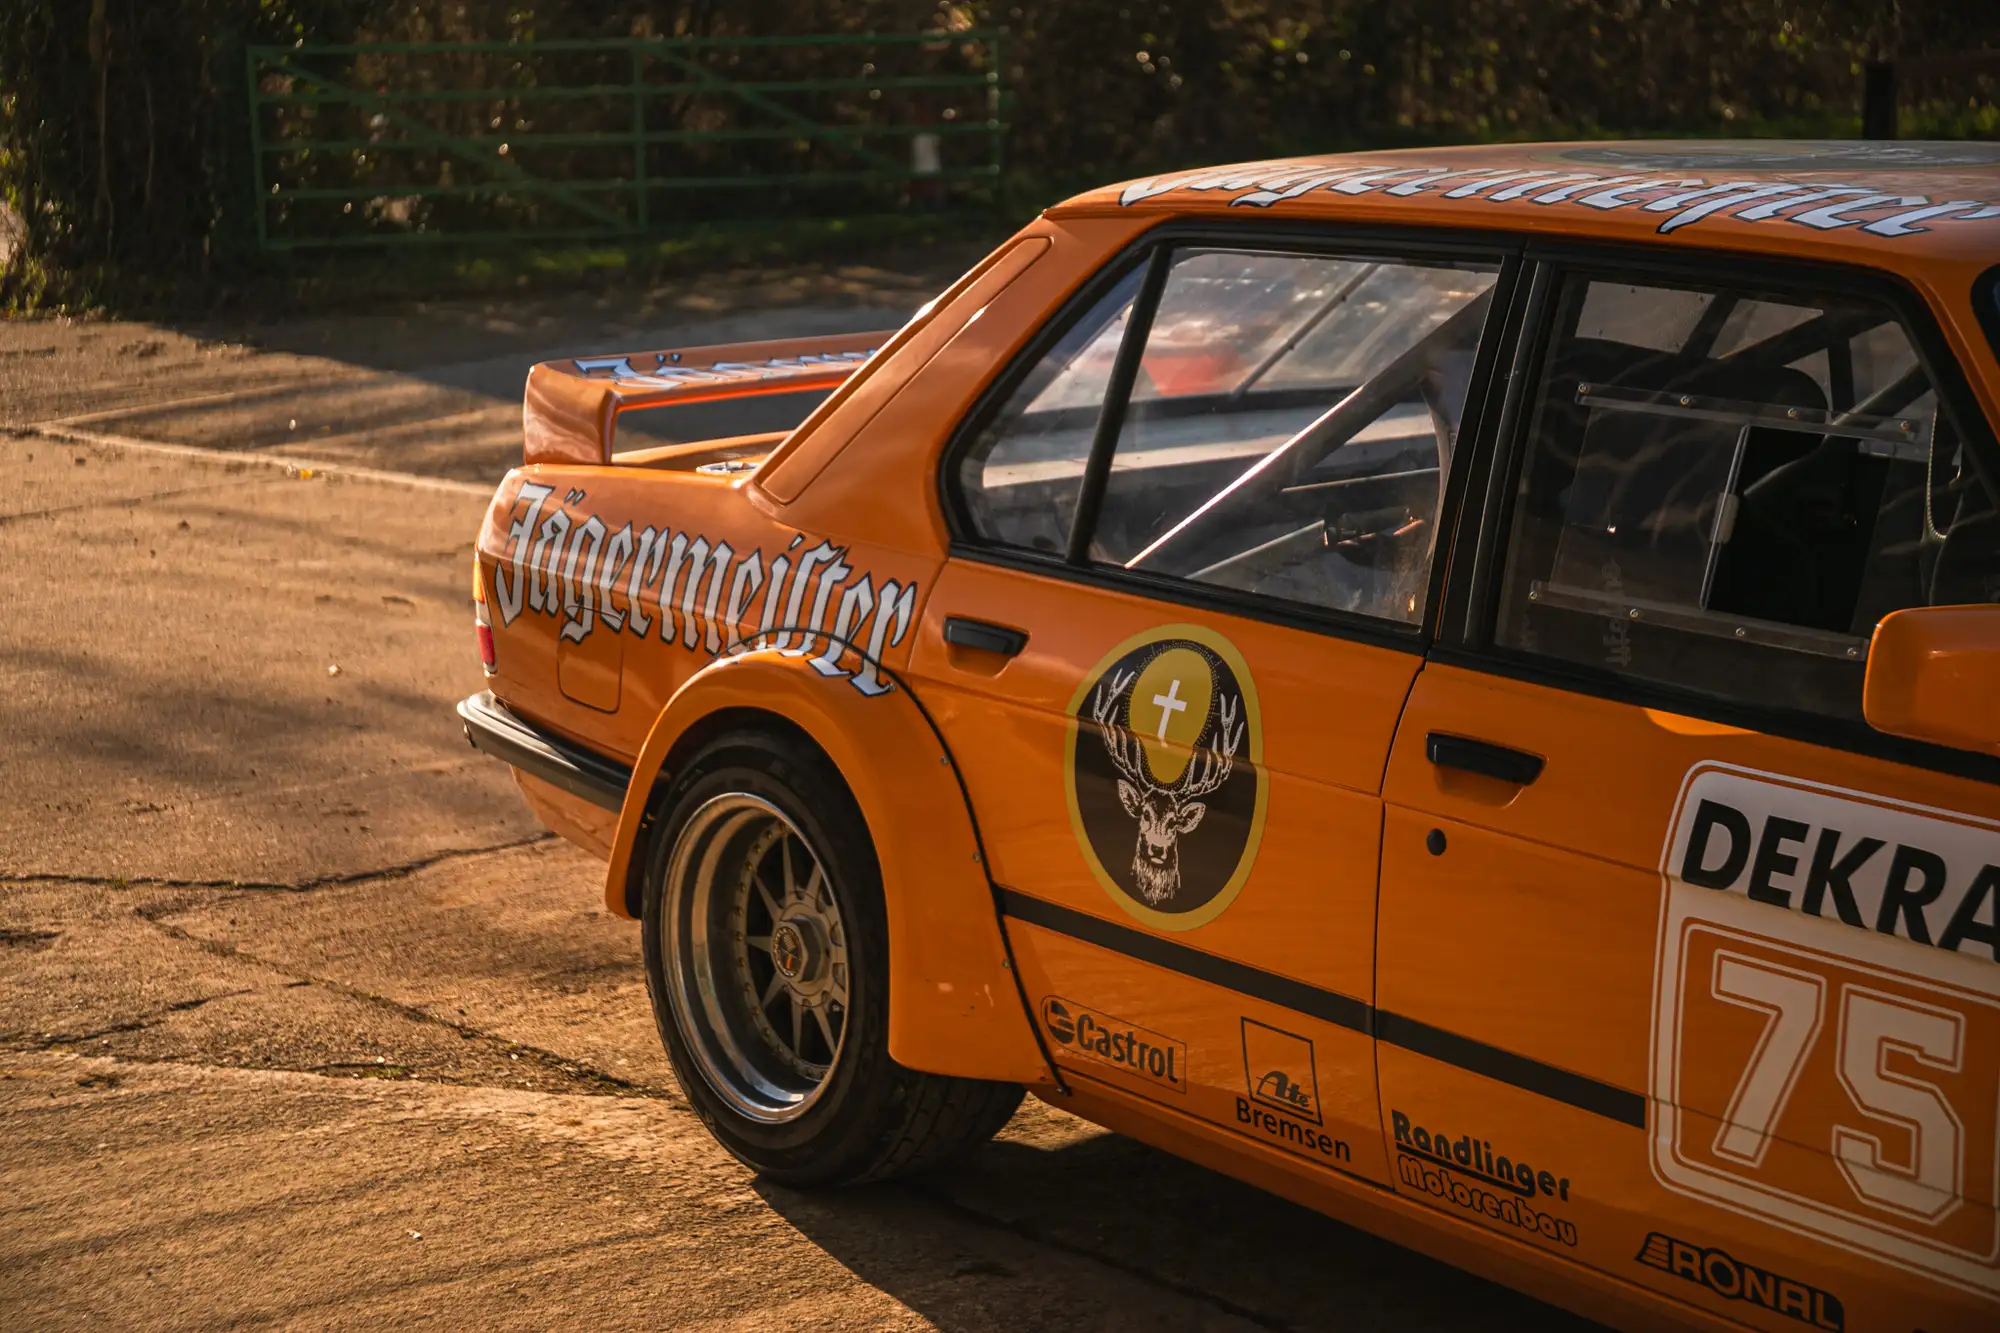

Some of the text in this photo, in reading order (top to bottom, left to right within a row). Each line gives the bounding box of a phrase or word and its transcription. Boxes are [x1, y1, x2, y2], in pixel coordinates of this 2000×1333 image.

[494, 480, 918, 698] Jägermeister
[1077, 1014, 1178, 1083] Castrol
[1711, 948, 1966, 1226] 75
[1236, 1097, 1350, 1161] Bremsen
[1392, 1109, 1570, 1202] Randlinger
[1398, 1154, 1577, 1247] Motorenbau
[1673, 1241, 1841, 1332] RONAL
